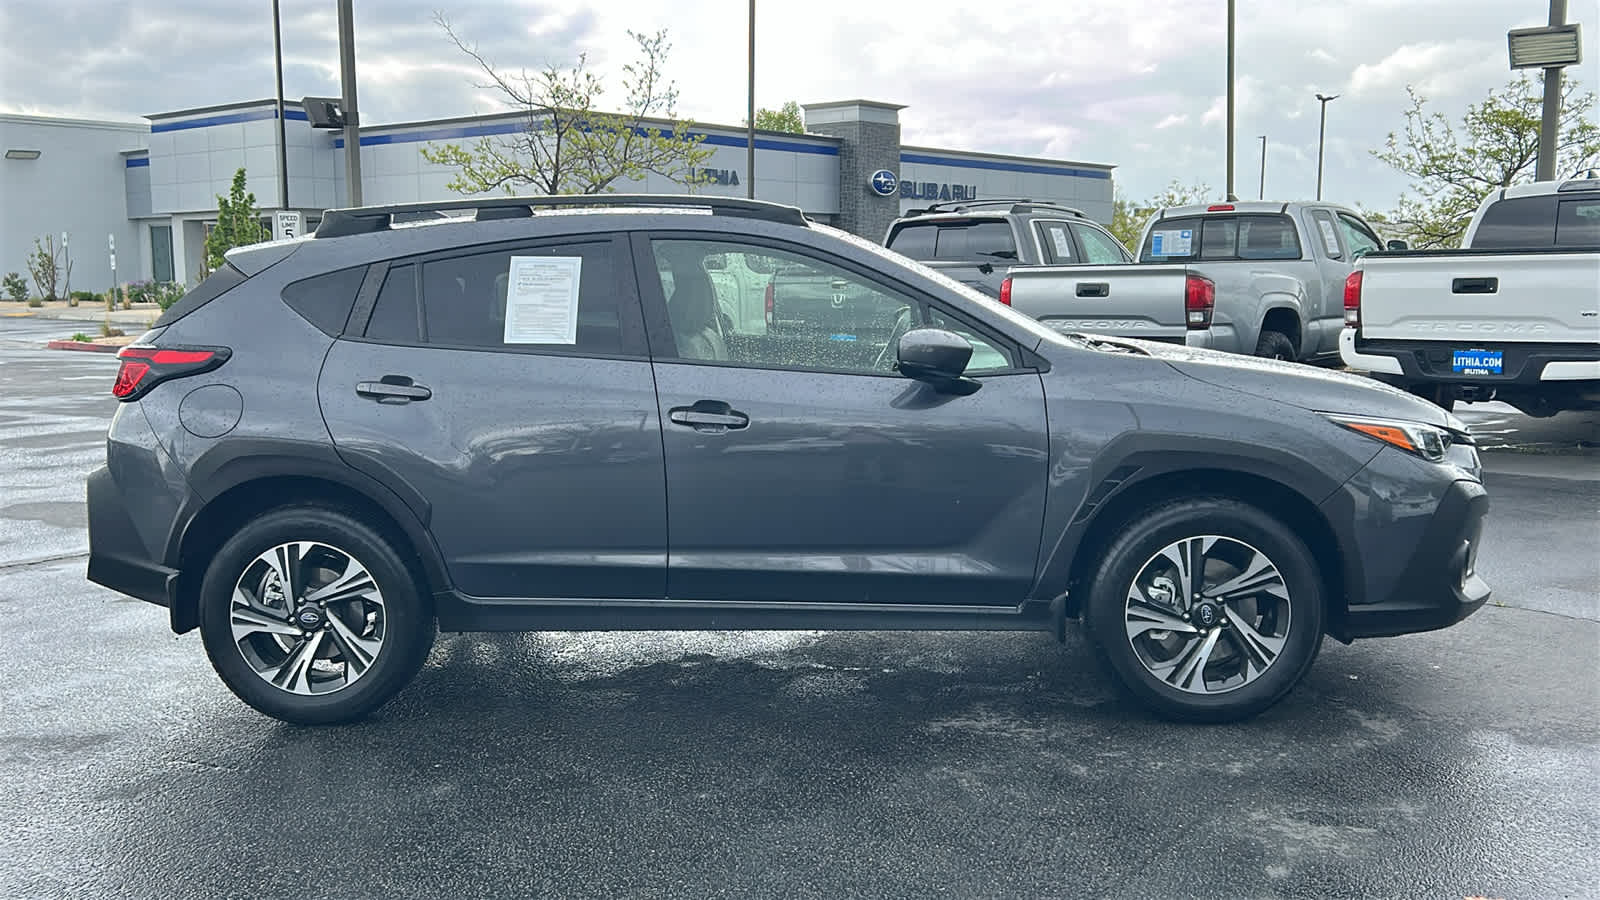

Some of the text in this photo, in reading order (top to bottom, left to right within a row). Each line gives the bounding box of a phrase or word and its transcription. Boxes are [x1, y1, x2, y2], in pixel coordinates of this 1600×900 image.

[900, 180, 976, 200] SUBARU
[286, 229, 294, 238] 5
[1045, 319, 1147, 330] TACOMA
[1409, 322, 1548, 333] TACOMA
[1453, 357, 1502, 367] LITHIA.COM
